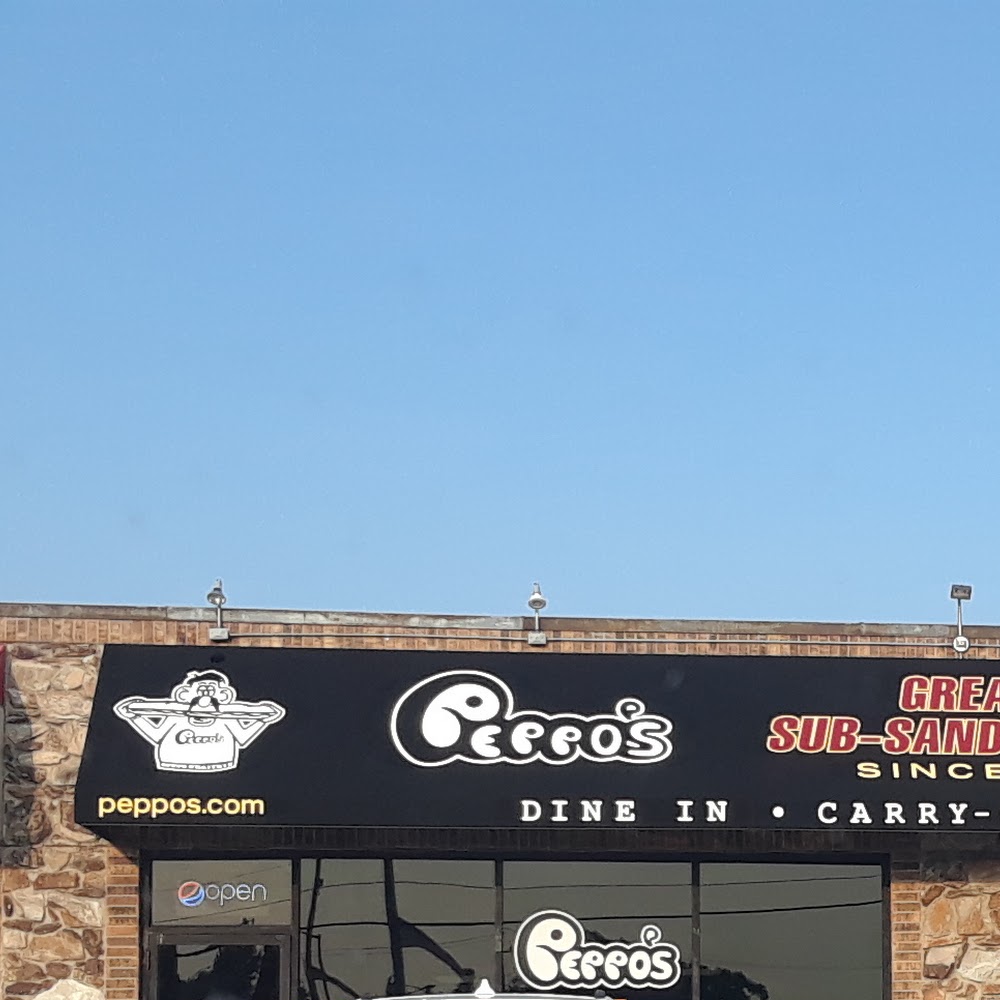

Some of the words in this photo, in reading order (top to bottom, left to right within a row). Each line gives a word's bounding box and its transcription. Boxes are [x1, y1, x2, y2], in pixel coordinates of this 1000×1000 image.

[98, 796, 265, 819] peppos.com
[520, 799, 636, 822] DINE
[677, 800, 728, 822] IN
[205, 881, 267, 906] open
